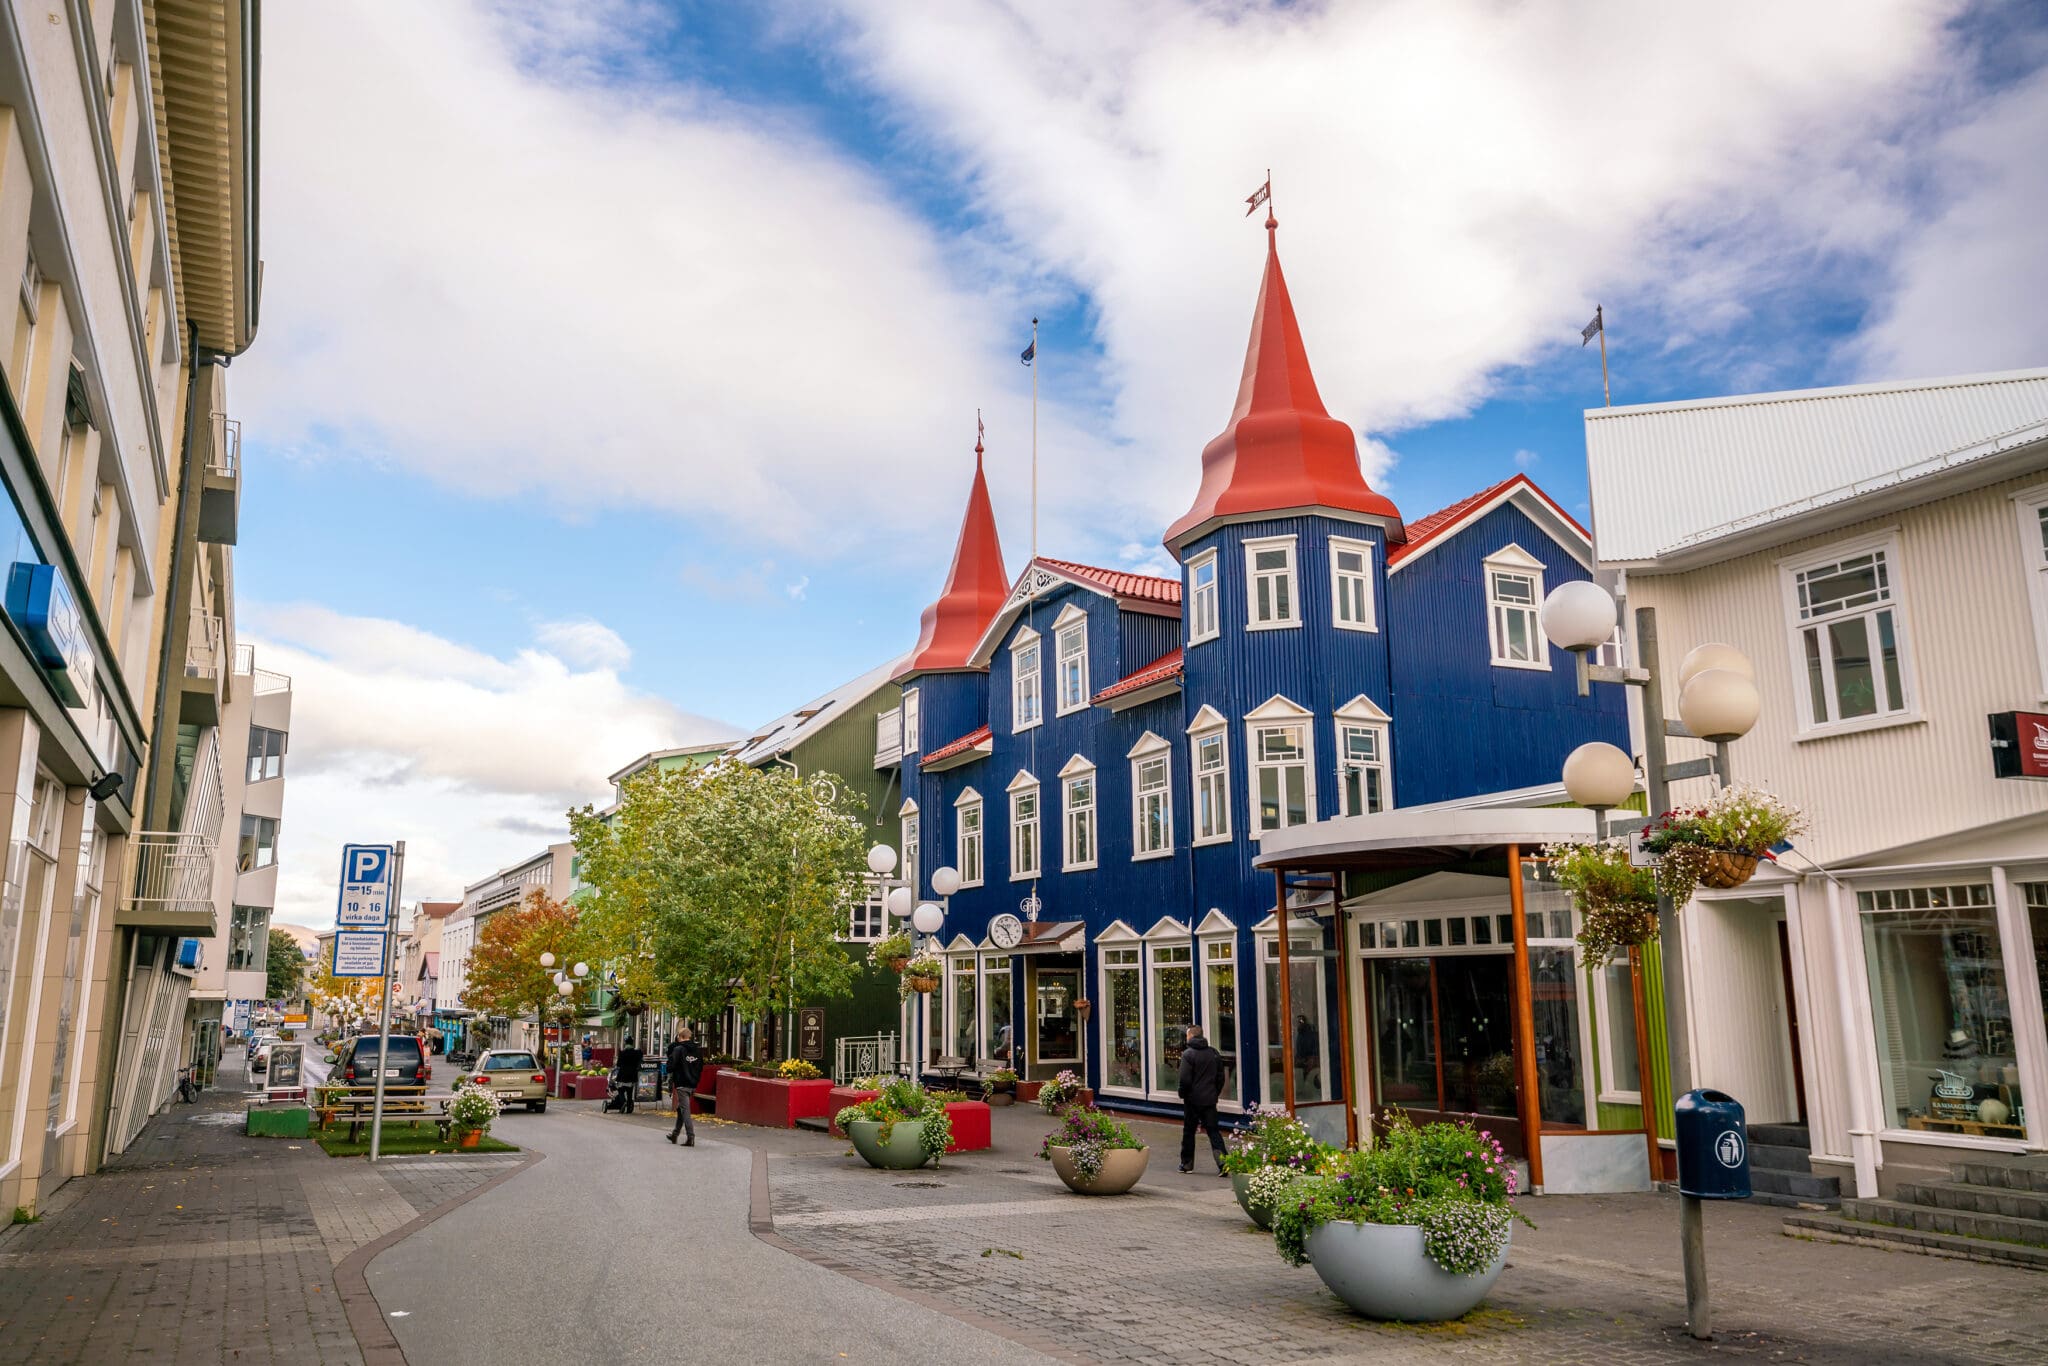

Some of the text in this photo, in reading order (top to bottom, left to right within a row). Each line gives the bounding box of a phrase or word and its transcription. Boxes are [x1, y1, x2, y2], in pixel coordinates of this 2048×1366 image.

[355, 852, 380, 881] P
[361, 885, 372, 895] 15
[347, 902, 359, 912] 10
[369, 902, 381, 912] 16
[345, 913, 380, 922] virka daga
